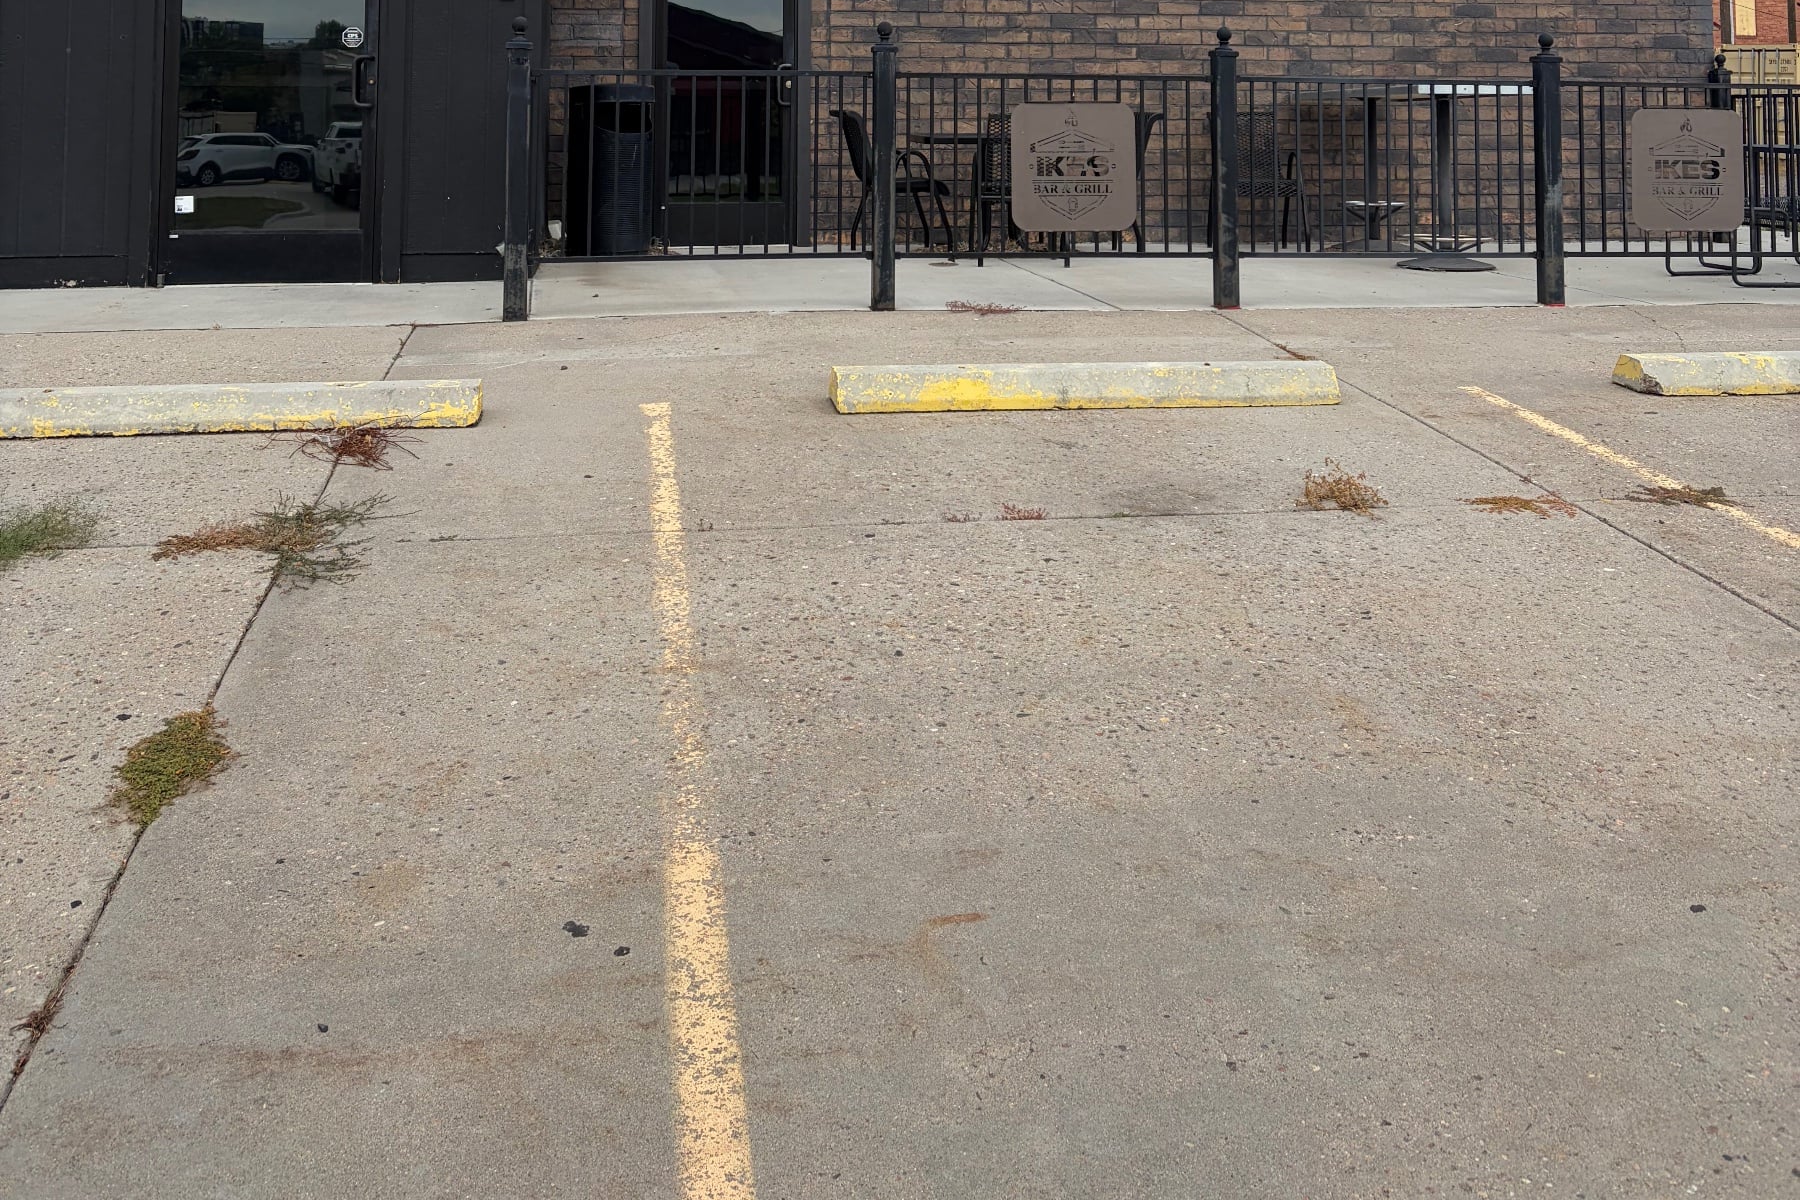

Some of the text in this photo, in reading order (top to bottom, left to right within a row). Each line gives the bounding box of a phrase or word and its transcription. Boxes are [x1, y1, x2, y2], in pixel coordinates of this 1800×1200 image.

[1033, 184, 1113, 194] BAR & GRILL
[1652, 186, 1675, 196] BAR
[1689, 186, 1725, 197] GRILL
